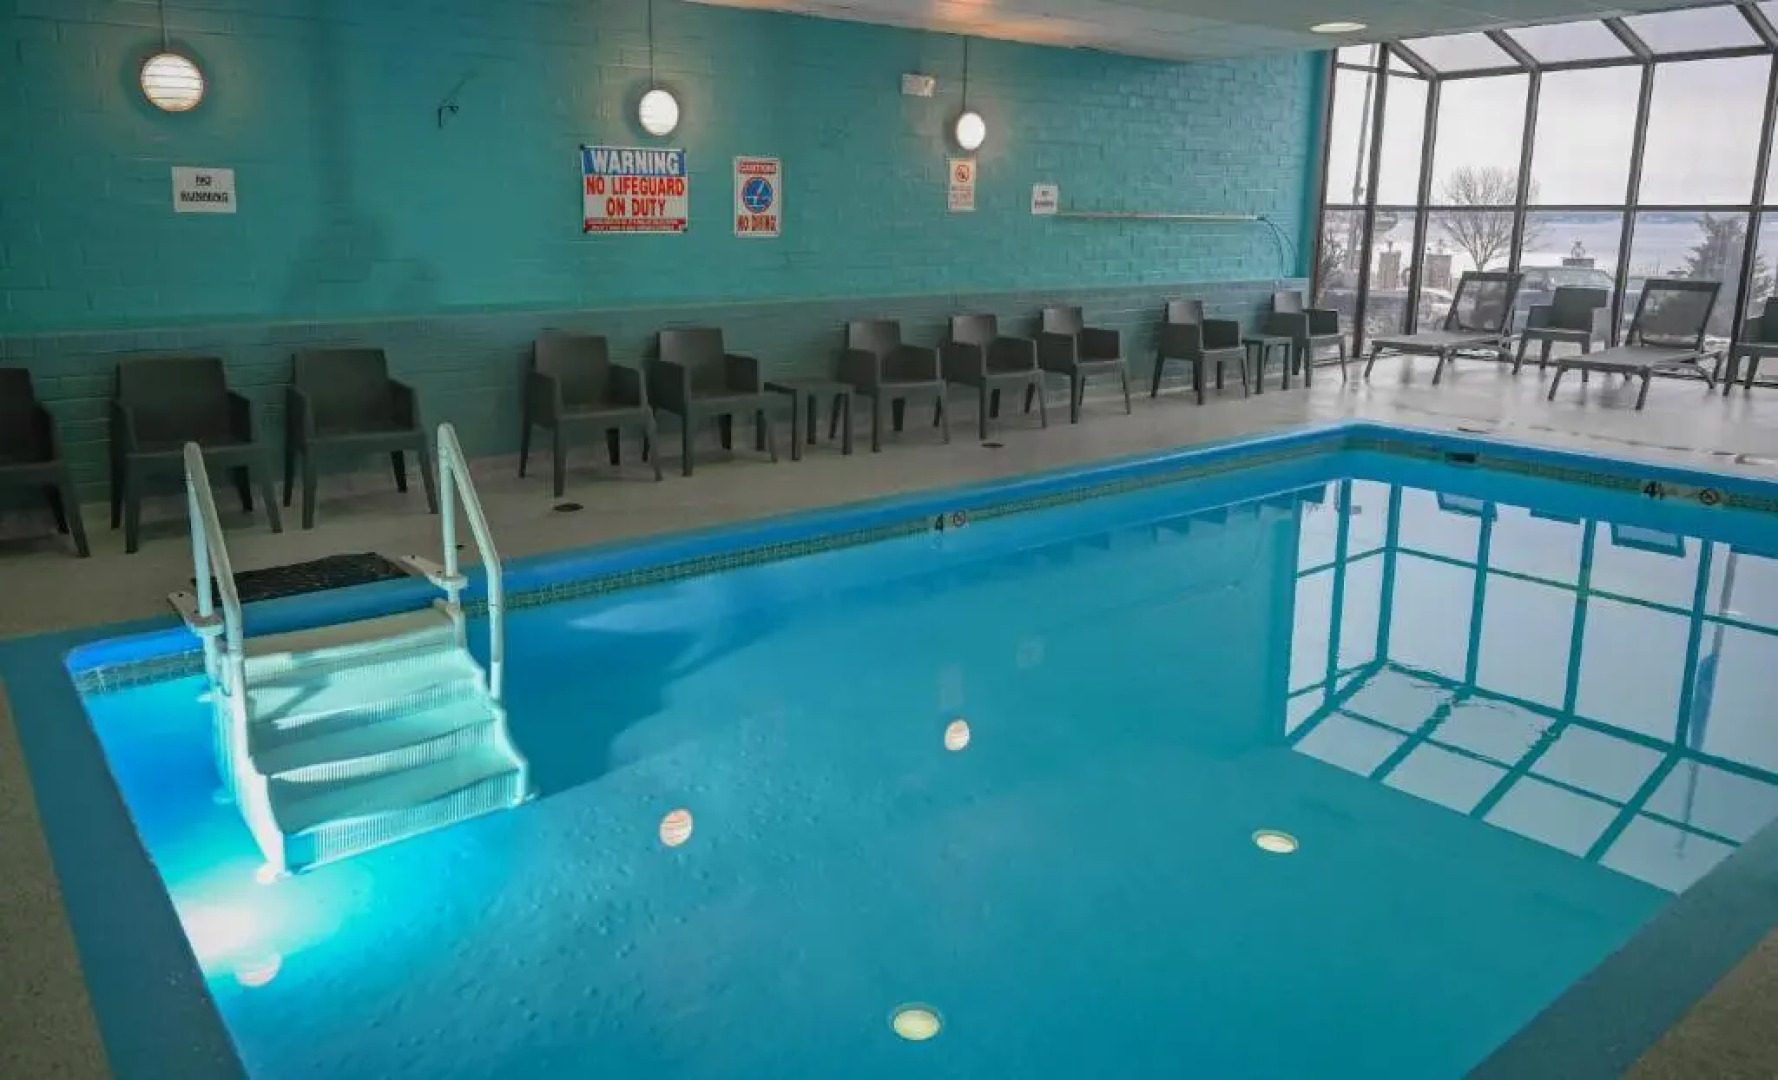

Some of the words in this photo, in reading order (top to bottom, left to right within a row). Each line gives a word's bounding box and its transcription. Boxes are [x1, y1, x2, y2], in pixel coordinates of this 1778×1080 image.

[591, 149, 679, 174] WARNING
[586, 176, 605, 195] NO
[612, 176, 685, 196] LIFEGUARD
[606, 198, 625, 216] ON
[632, 198, 665, 216] DUTY
